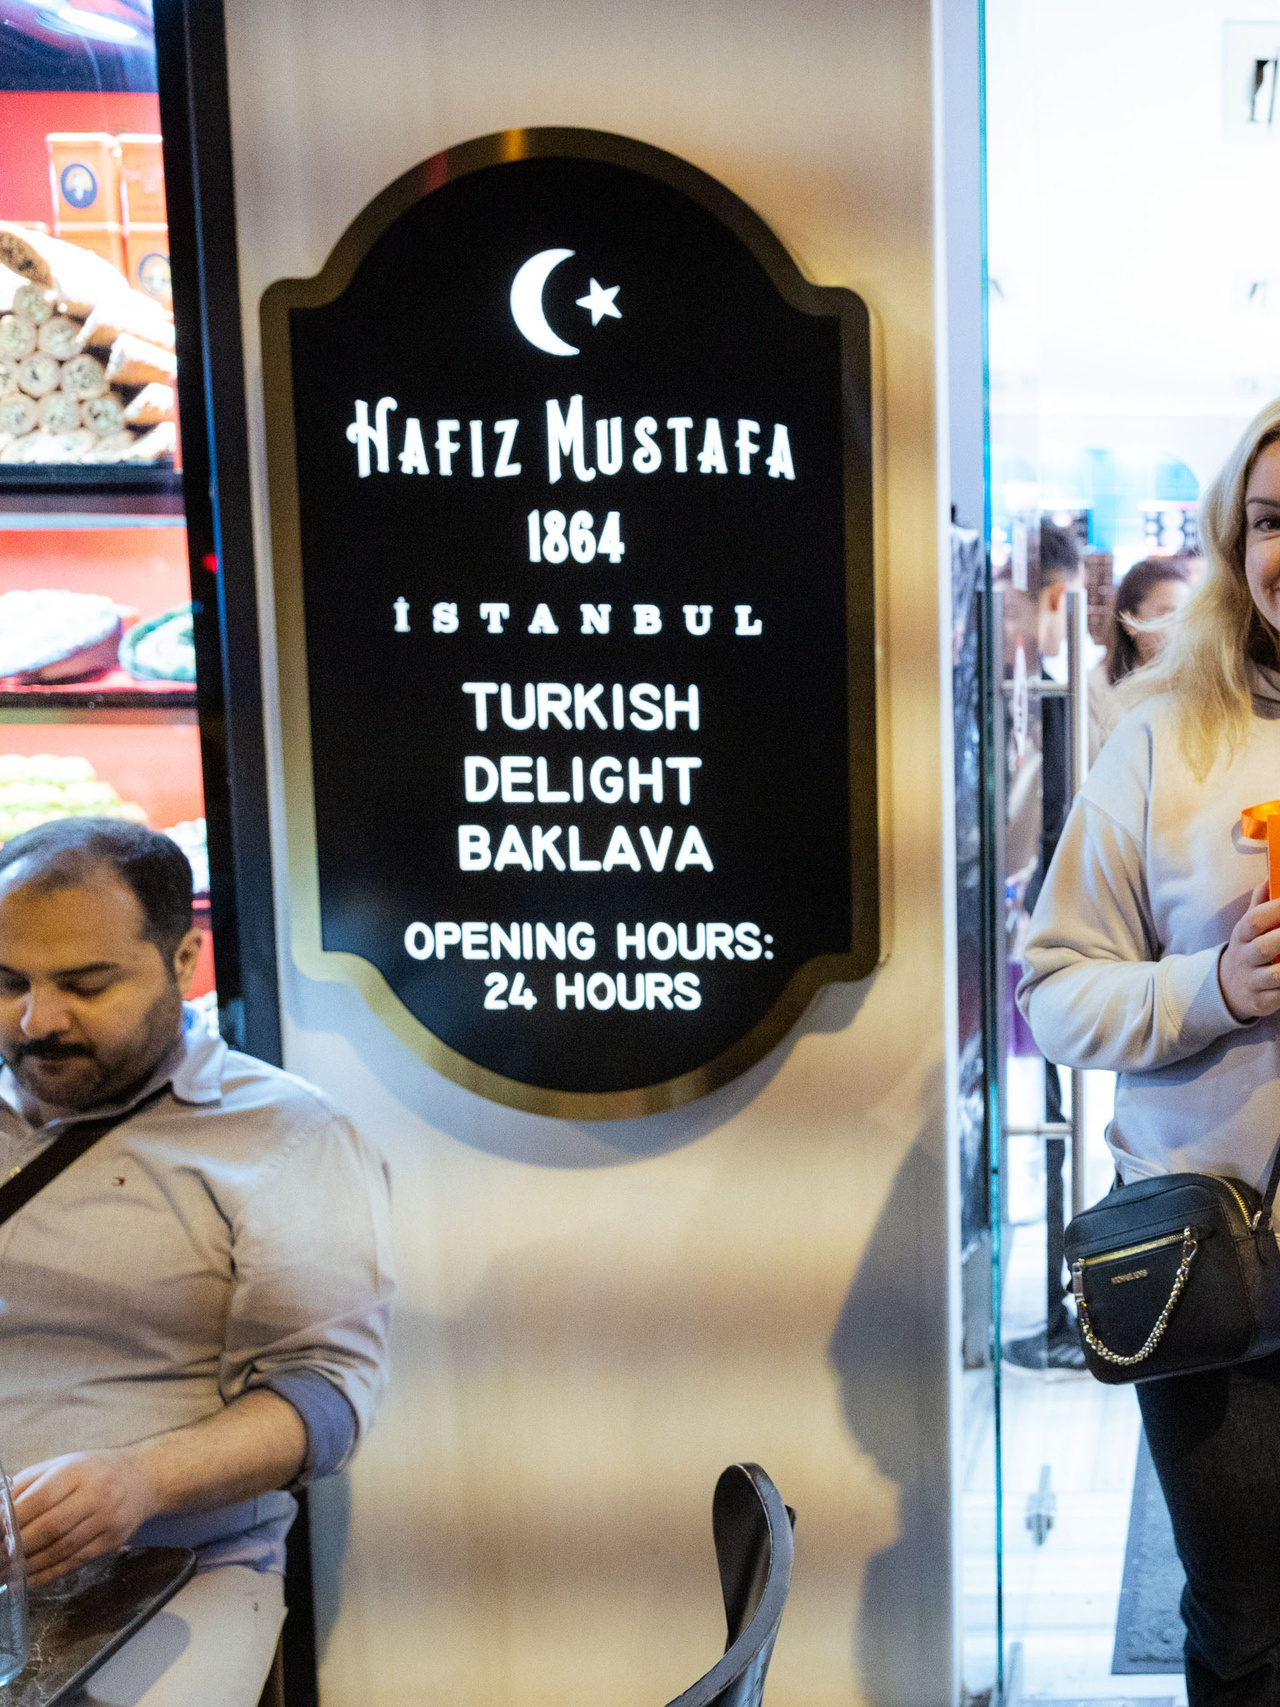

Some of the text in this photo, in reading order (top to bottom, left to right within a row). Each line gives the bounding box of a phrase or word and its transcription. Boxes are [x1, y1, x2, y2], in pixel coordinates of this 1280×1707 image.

[345, 393, 797, 485] HAFIZ MUSTAFA
[527, 508, 625, 564] 1864
[393, 596, 763, 636] İSTANBUL
[461, 681, 700, 732] TURKISH
[463, 755, 703, 806] DELIGHT
[457, 824, 714, 873] BAKLAVA
[403, 921, 774, 960] OPENING HOURS:
[483, 971, 702, 1010] 24 HOURS
